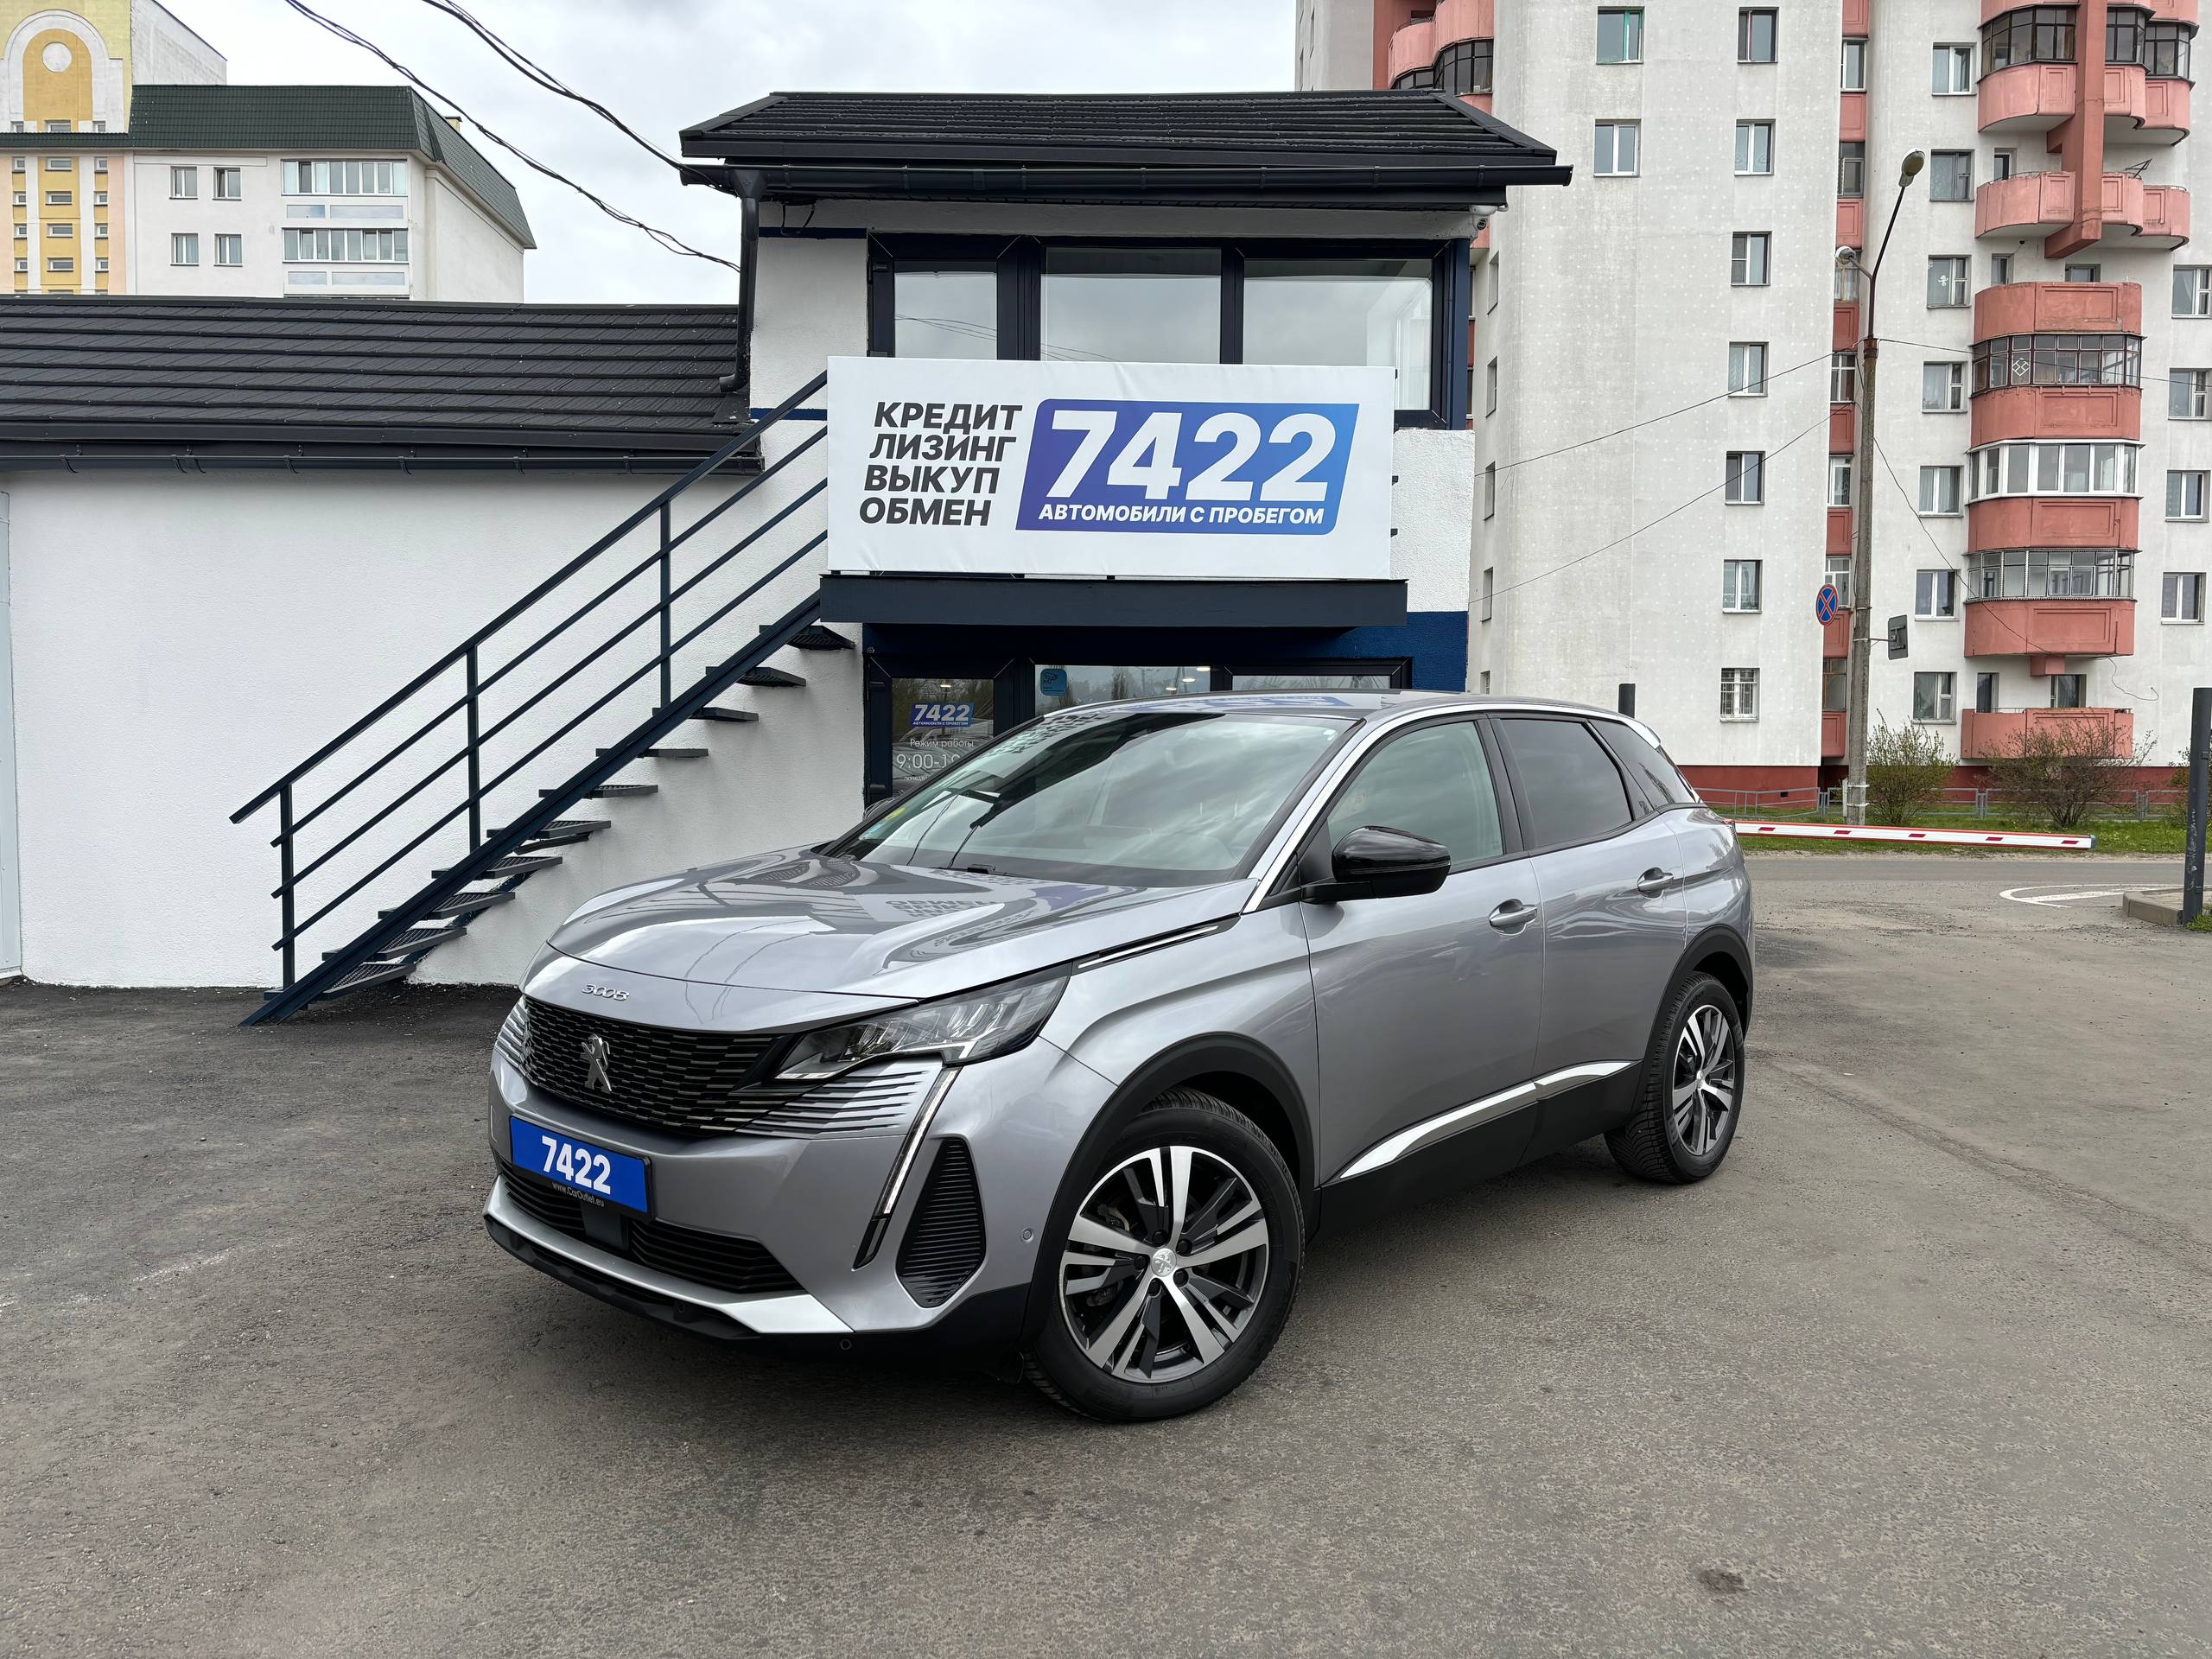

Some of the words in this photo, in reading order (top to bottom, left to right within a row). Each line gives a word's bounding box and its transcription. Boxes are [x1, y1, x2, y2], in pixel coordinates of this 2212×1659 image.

[874, 401, 1023, 435] КРЕДИТ
[868, 433, 1017, 462] ЛИЗИНГ
[1046, 410, 1337, 502] 7422
[864, 464, 1000, 494] ВЫКУП
[859, 497, 992, 526] ОБМЕН
[1038, 504, 1186, 523] АВТОМОБИЛИ
[1190, 505, 1205, 524] С
[1208, 506, 1325, 524] ПРОБЕГОМ
[914, 704, 970, 721] 7422
[910, 739, 939, 747] Режим
[941, 739, 974, 749] работы
[582, 983, 630, 1001] 3008
[542, 1135, 611, 1195] 7422
[551, 1181, 605, 1208] www.CarOutlet.eu
